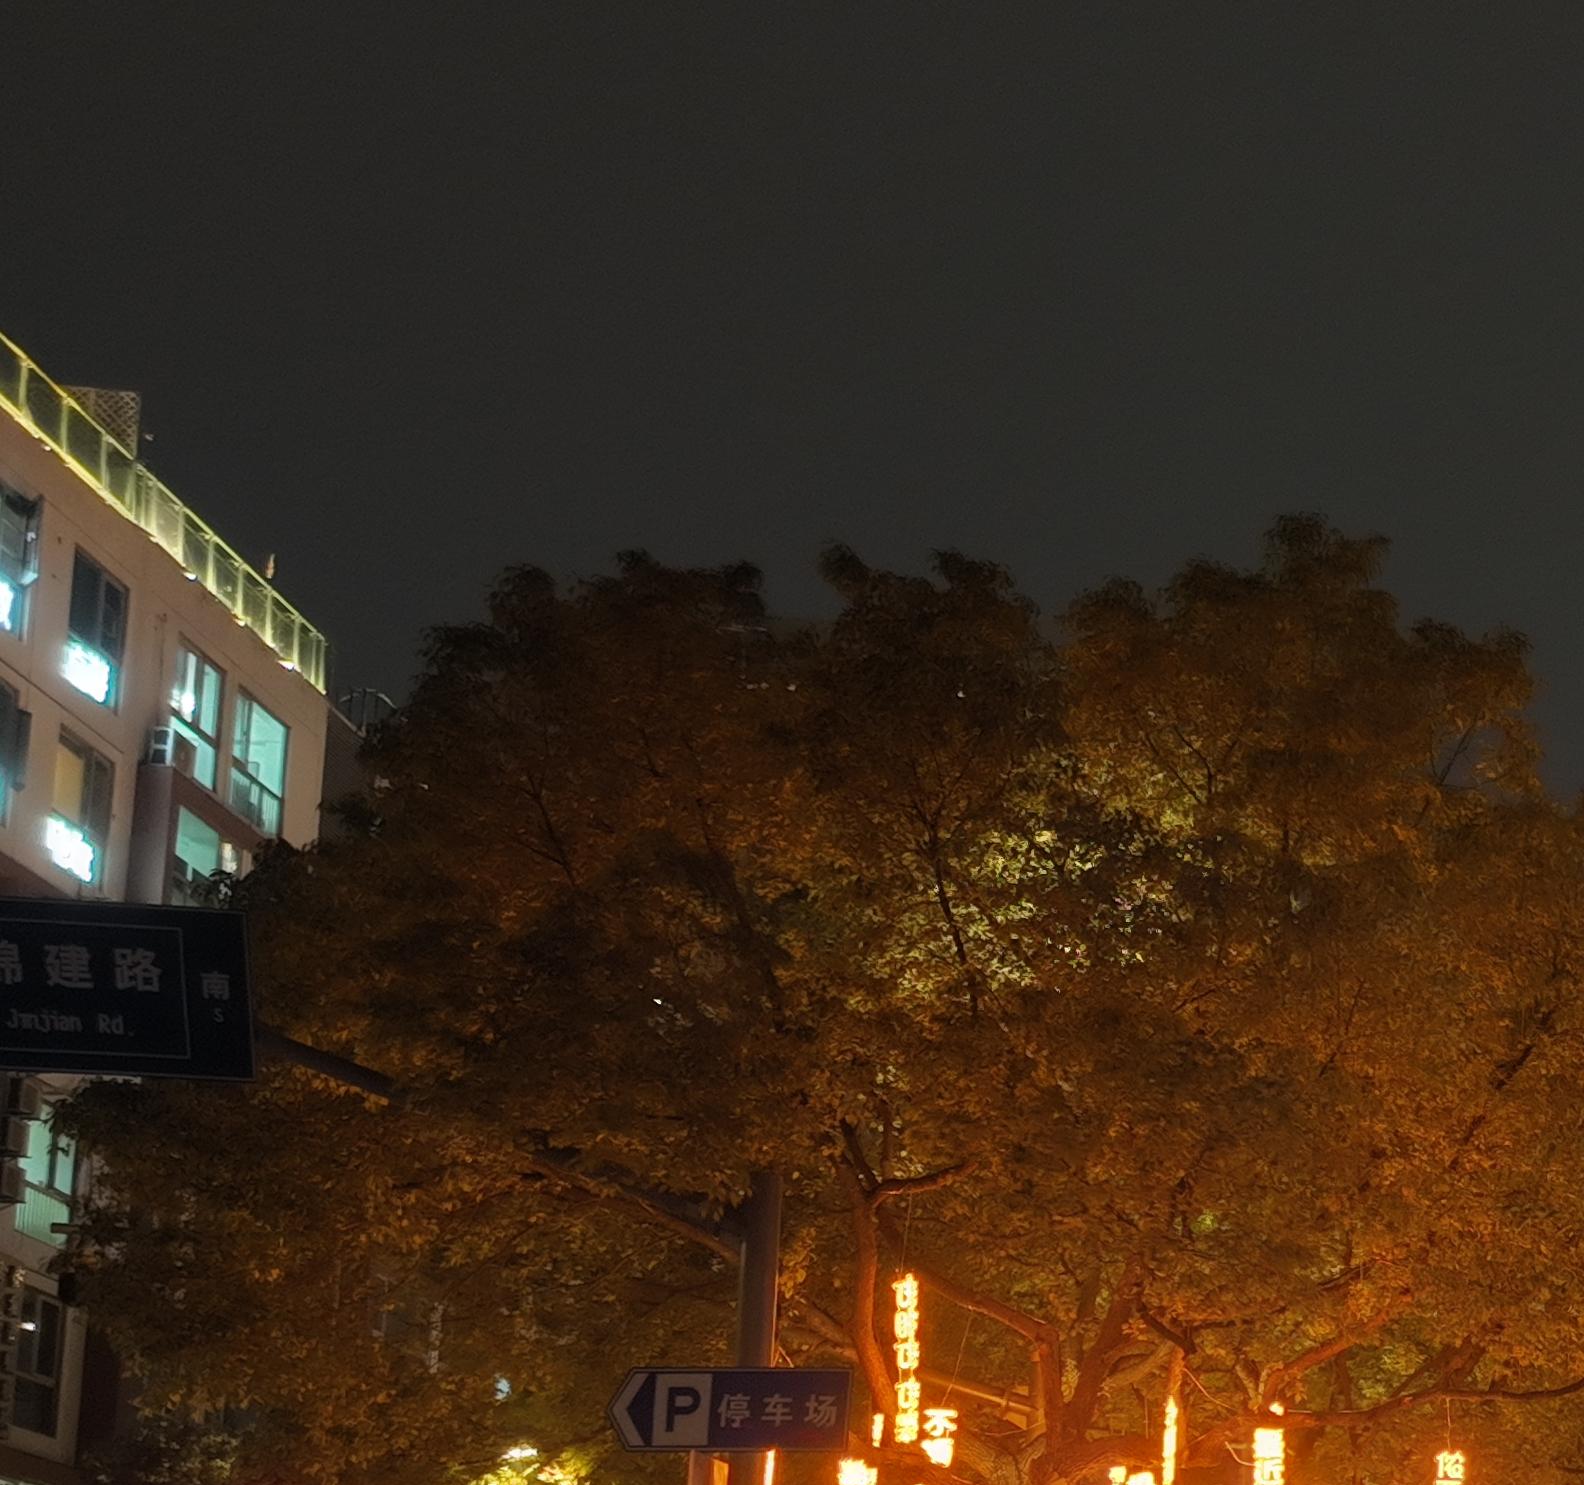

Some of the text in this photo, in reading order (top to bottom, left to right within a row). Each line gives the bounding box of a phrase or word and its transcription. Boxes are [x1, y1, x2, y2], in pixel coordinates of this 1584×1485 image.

[201, 971, 230, 1000] 南
[99, 1012, 135, 1037] Rd.
[213, 1007, 225, 1024] S
[665, 1386, 702, 1432] P
[717, 1393, 839, 1430] 停车场
